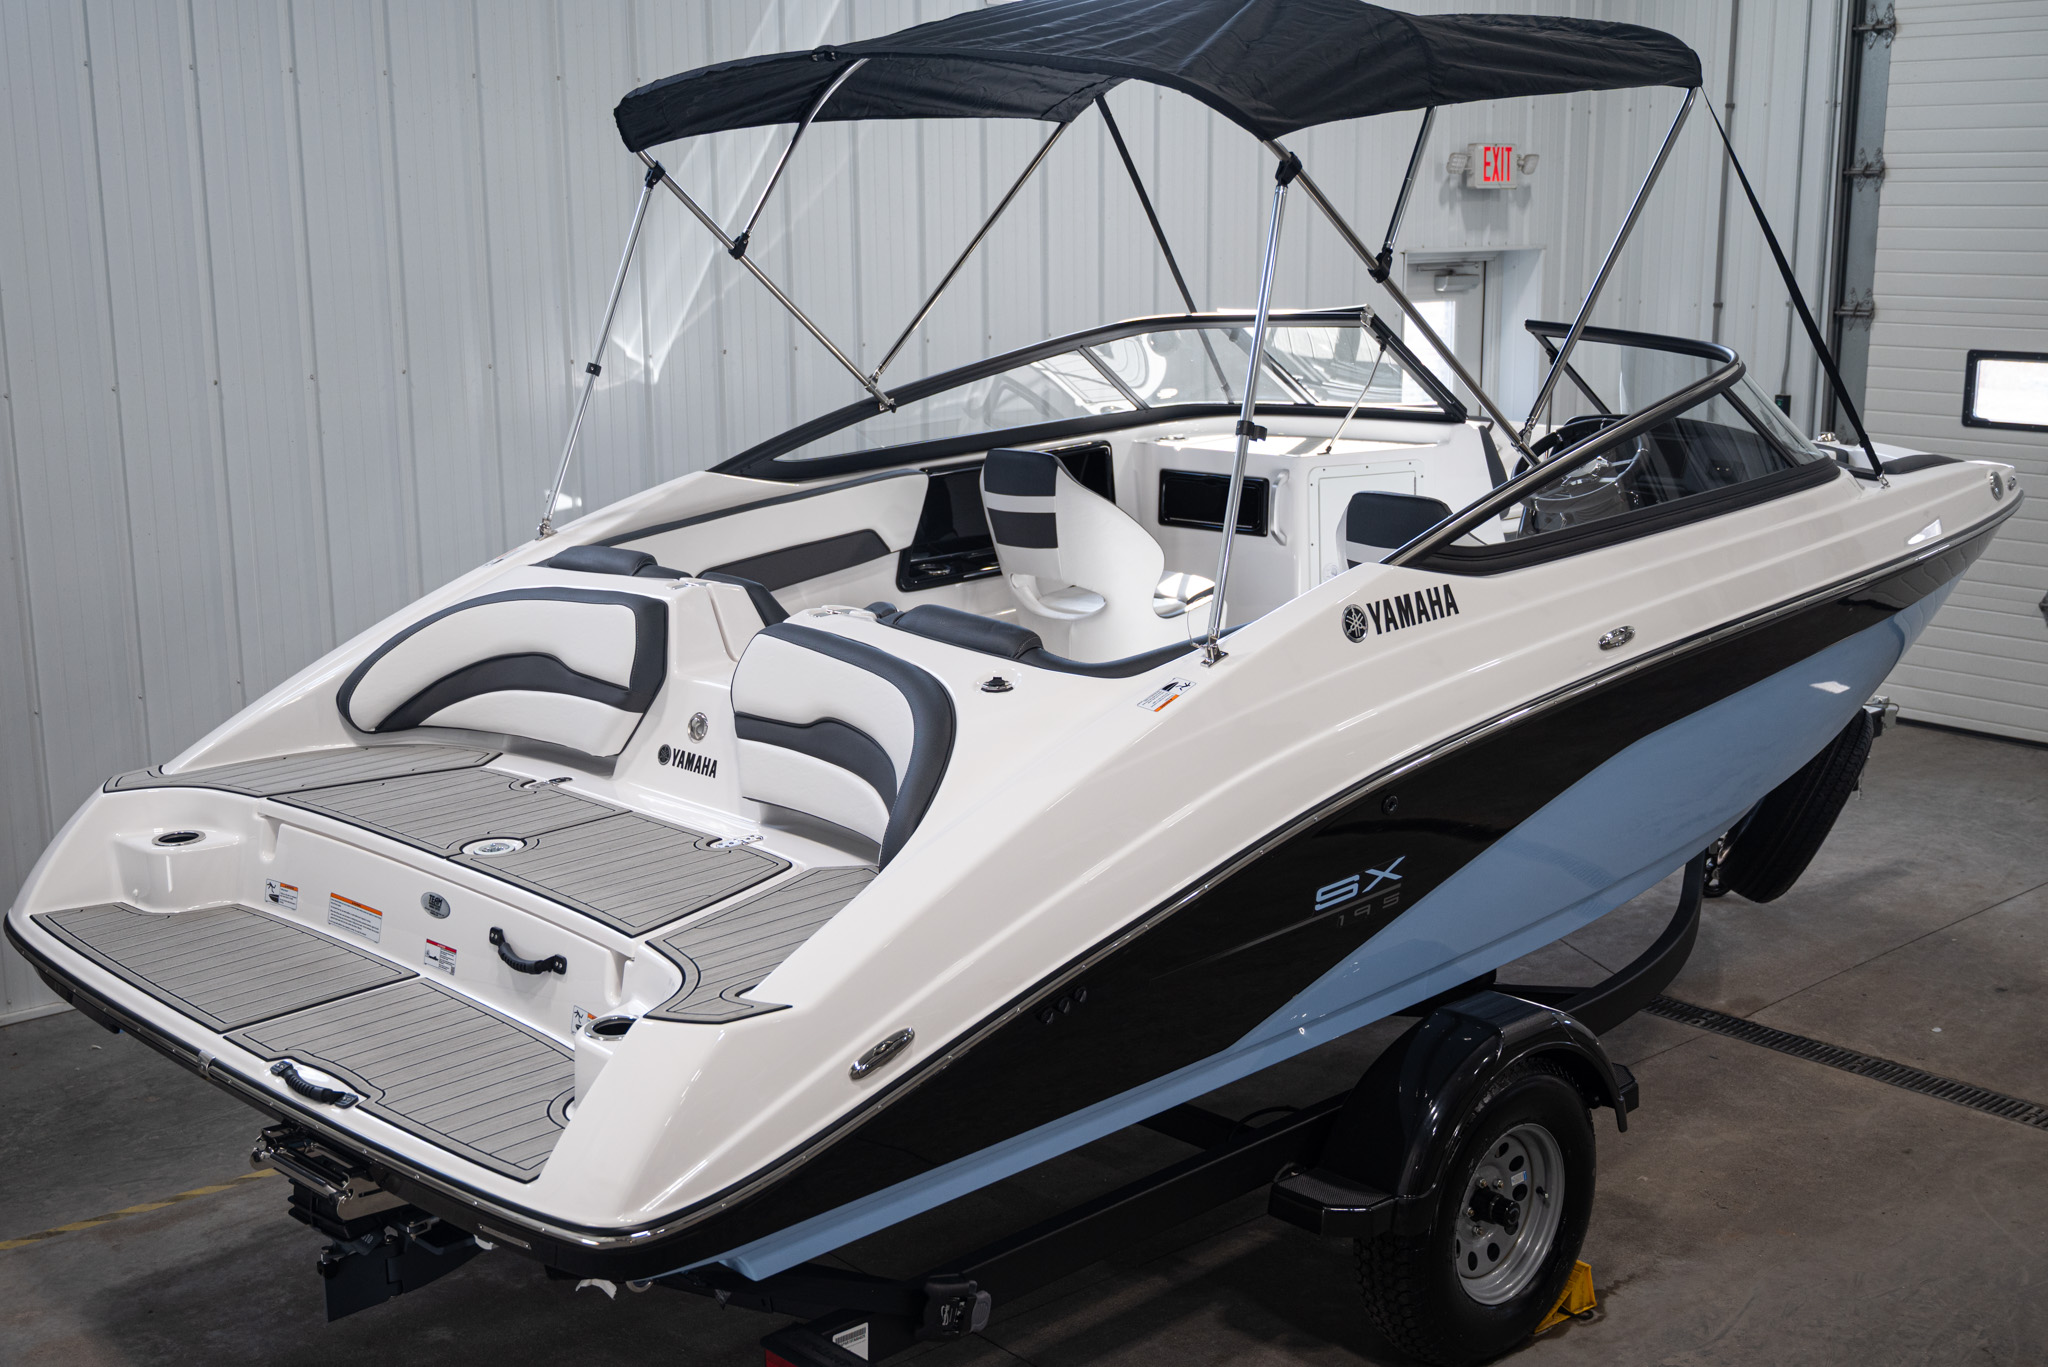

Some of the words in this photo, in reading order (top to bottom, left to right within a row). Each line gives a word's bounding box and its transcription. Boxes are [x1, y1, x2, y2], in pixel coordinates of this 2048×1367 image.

[1483, 147, 1512, 182] EXIT
[1366, 584, 1459, 635] YAMAHA
[672, 748, 717, 778] YAMAHA
[1315, 855, 1406, 911] SX
[1339, 892, 1400, 926] 195
